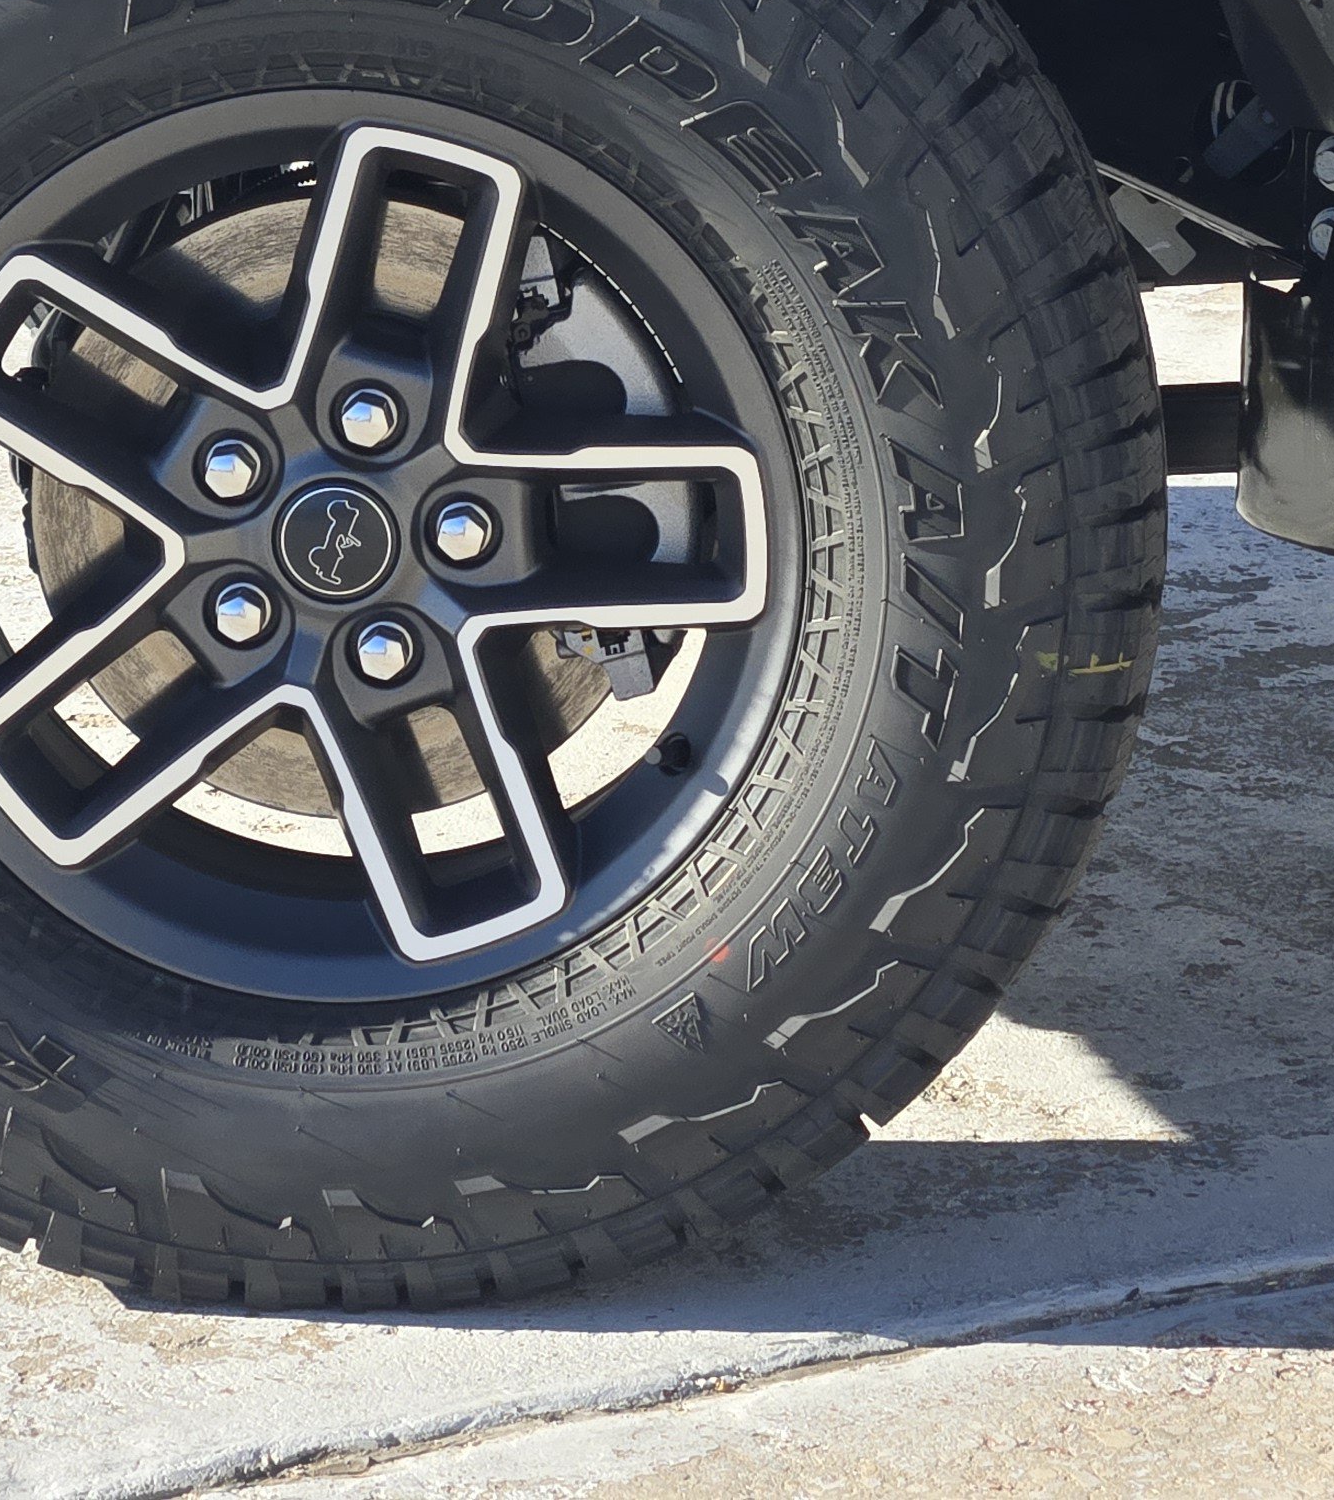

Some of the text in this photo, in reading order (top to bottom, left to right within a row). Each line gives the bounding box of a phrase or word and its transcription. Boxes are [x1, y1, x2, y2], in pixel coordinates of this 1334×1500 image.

[570, 990, 601, 1013] LOAD
[536, 1006, 568, 1028] DUAL
[575, 1000, 607, 1025] LOAD
[477, 1030, 494, 1046] kg
[496, 1023, 524, 1042] 1150
[530, 1017, 574, 1044] SINGLE
[480, 1042, 498, 1058] kg
[500, 1034, 528, 1054] 1250
